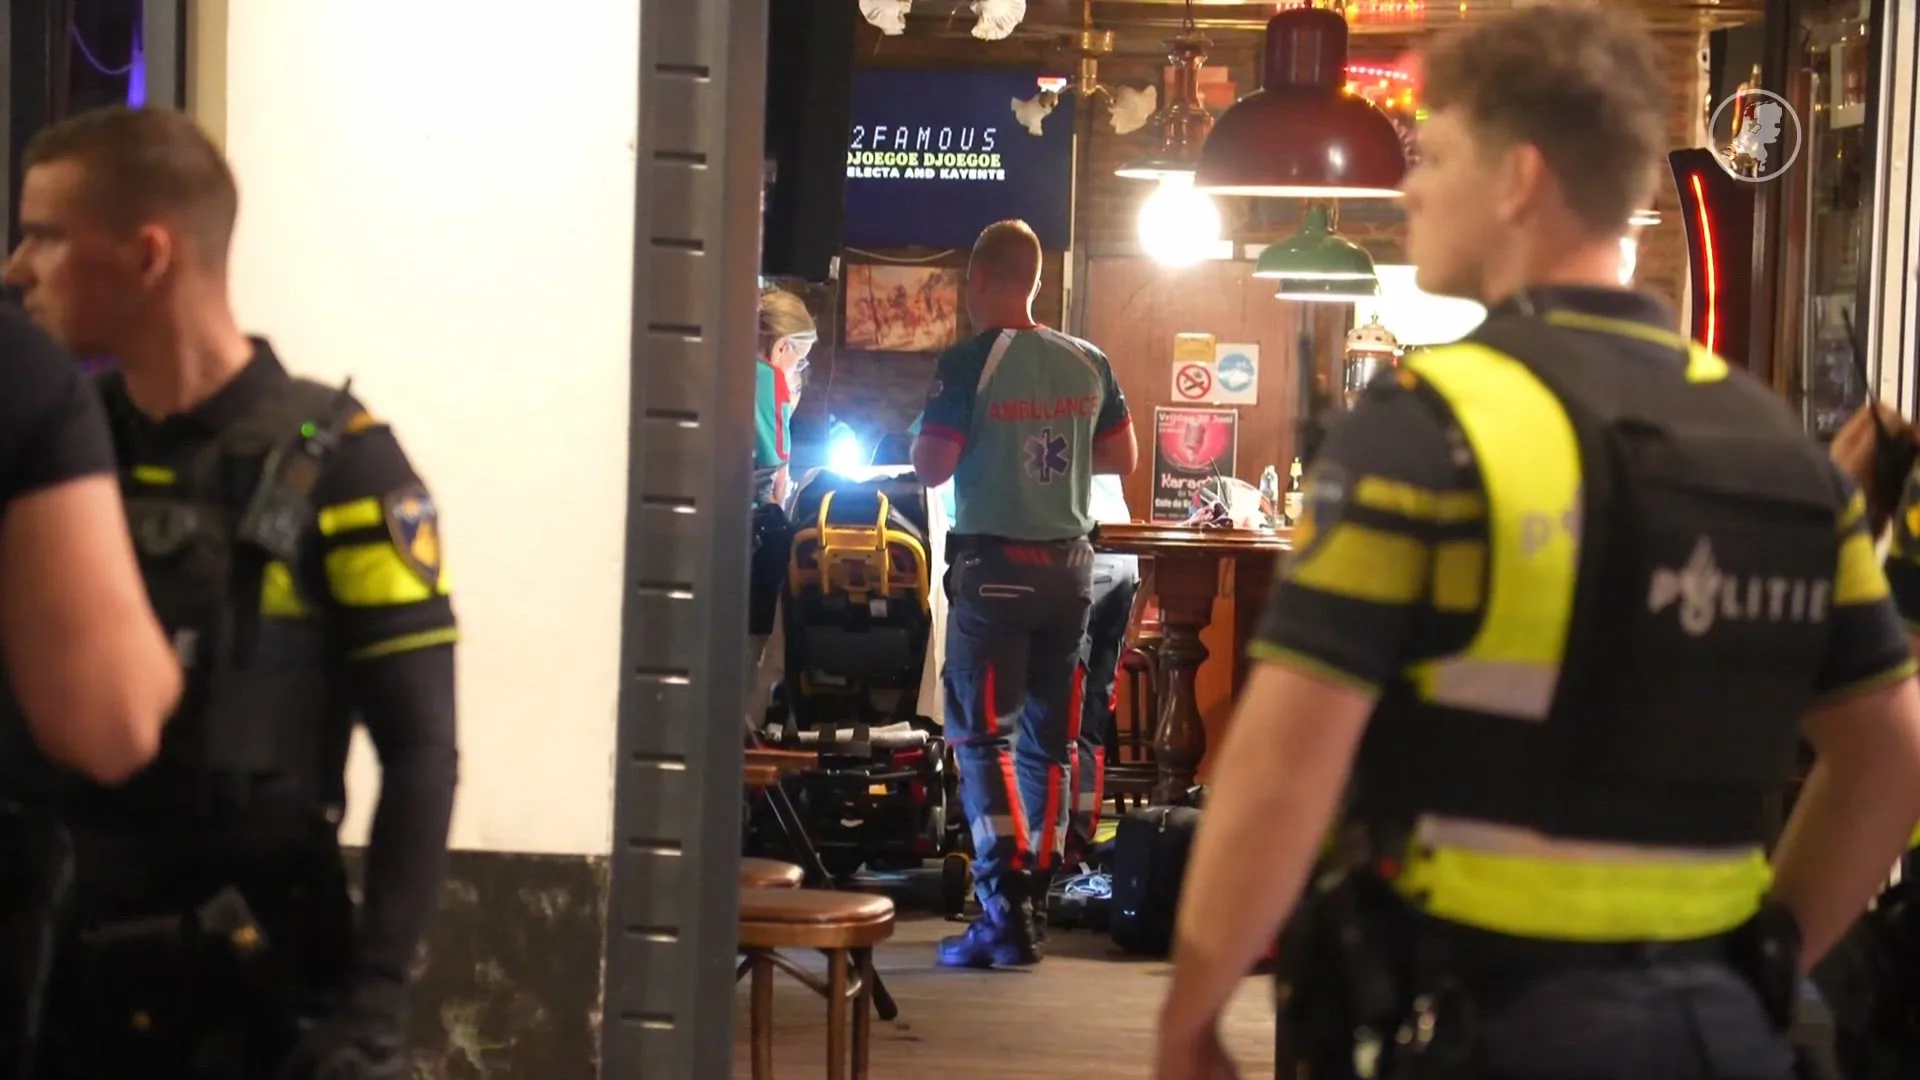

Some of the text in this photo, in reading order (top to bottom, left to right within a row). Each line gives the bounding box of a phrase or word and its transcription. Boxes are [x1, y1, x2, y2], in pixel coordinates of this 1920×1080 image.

[850, 125, 997, 151] 2FAMOUS
[923, 153, 1001, 167] DJOEGOE
[904, 168, 936, 179] AND
